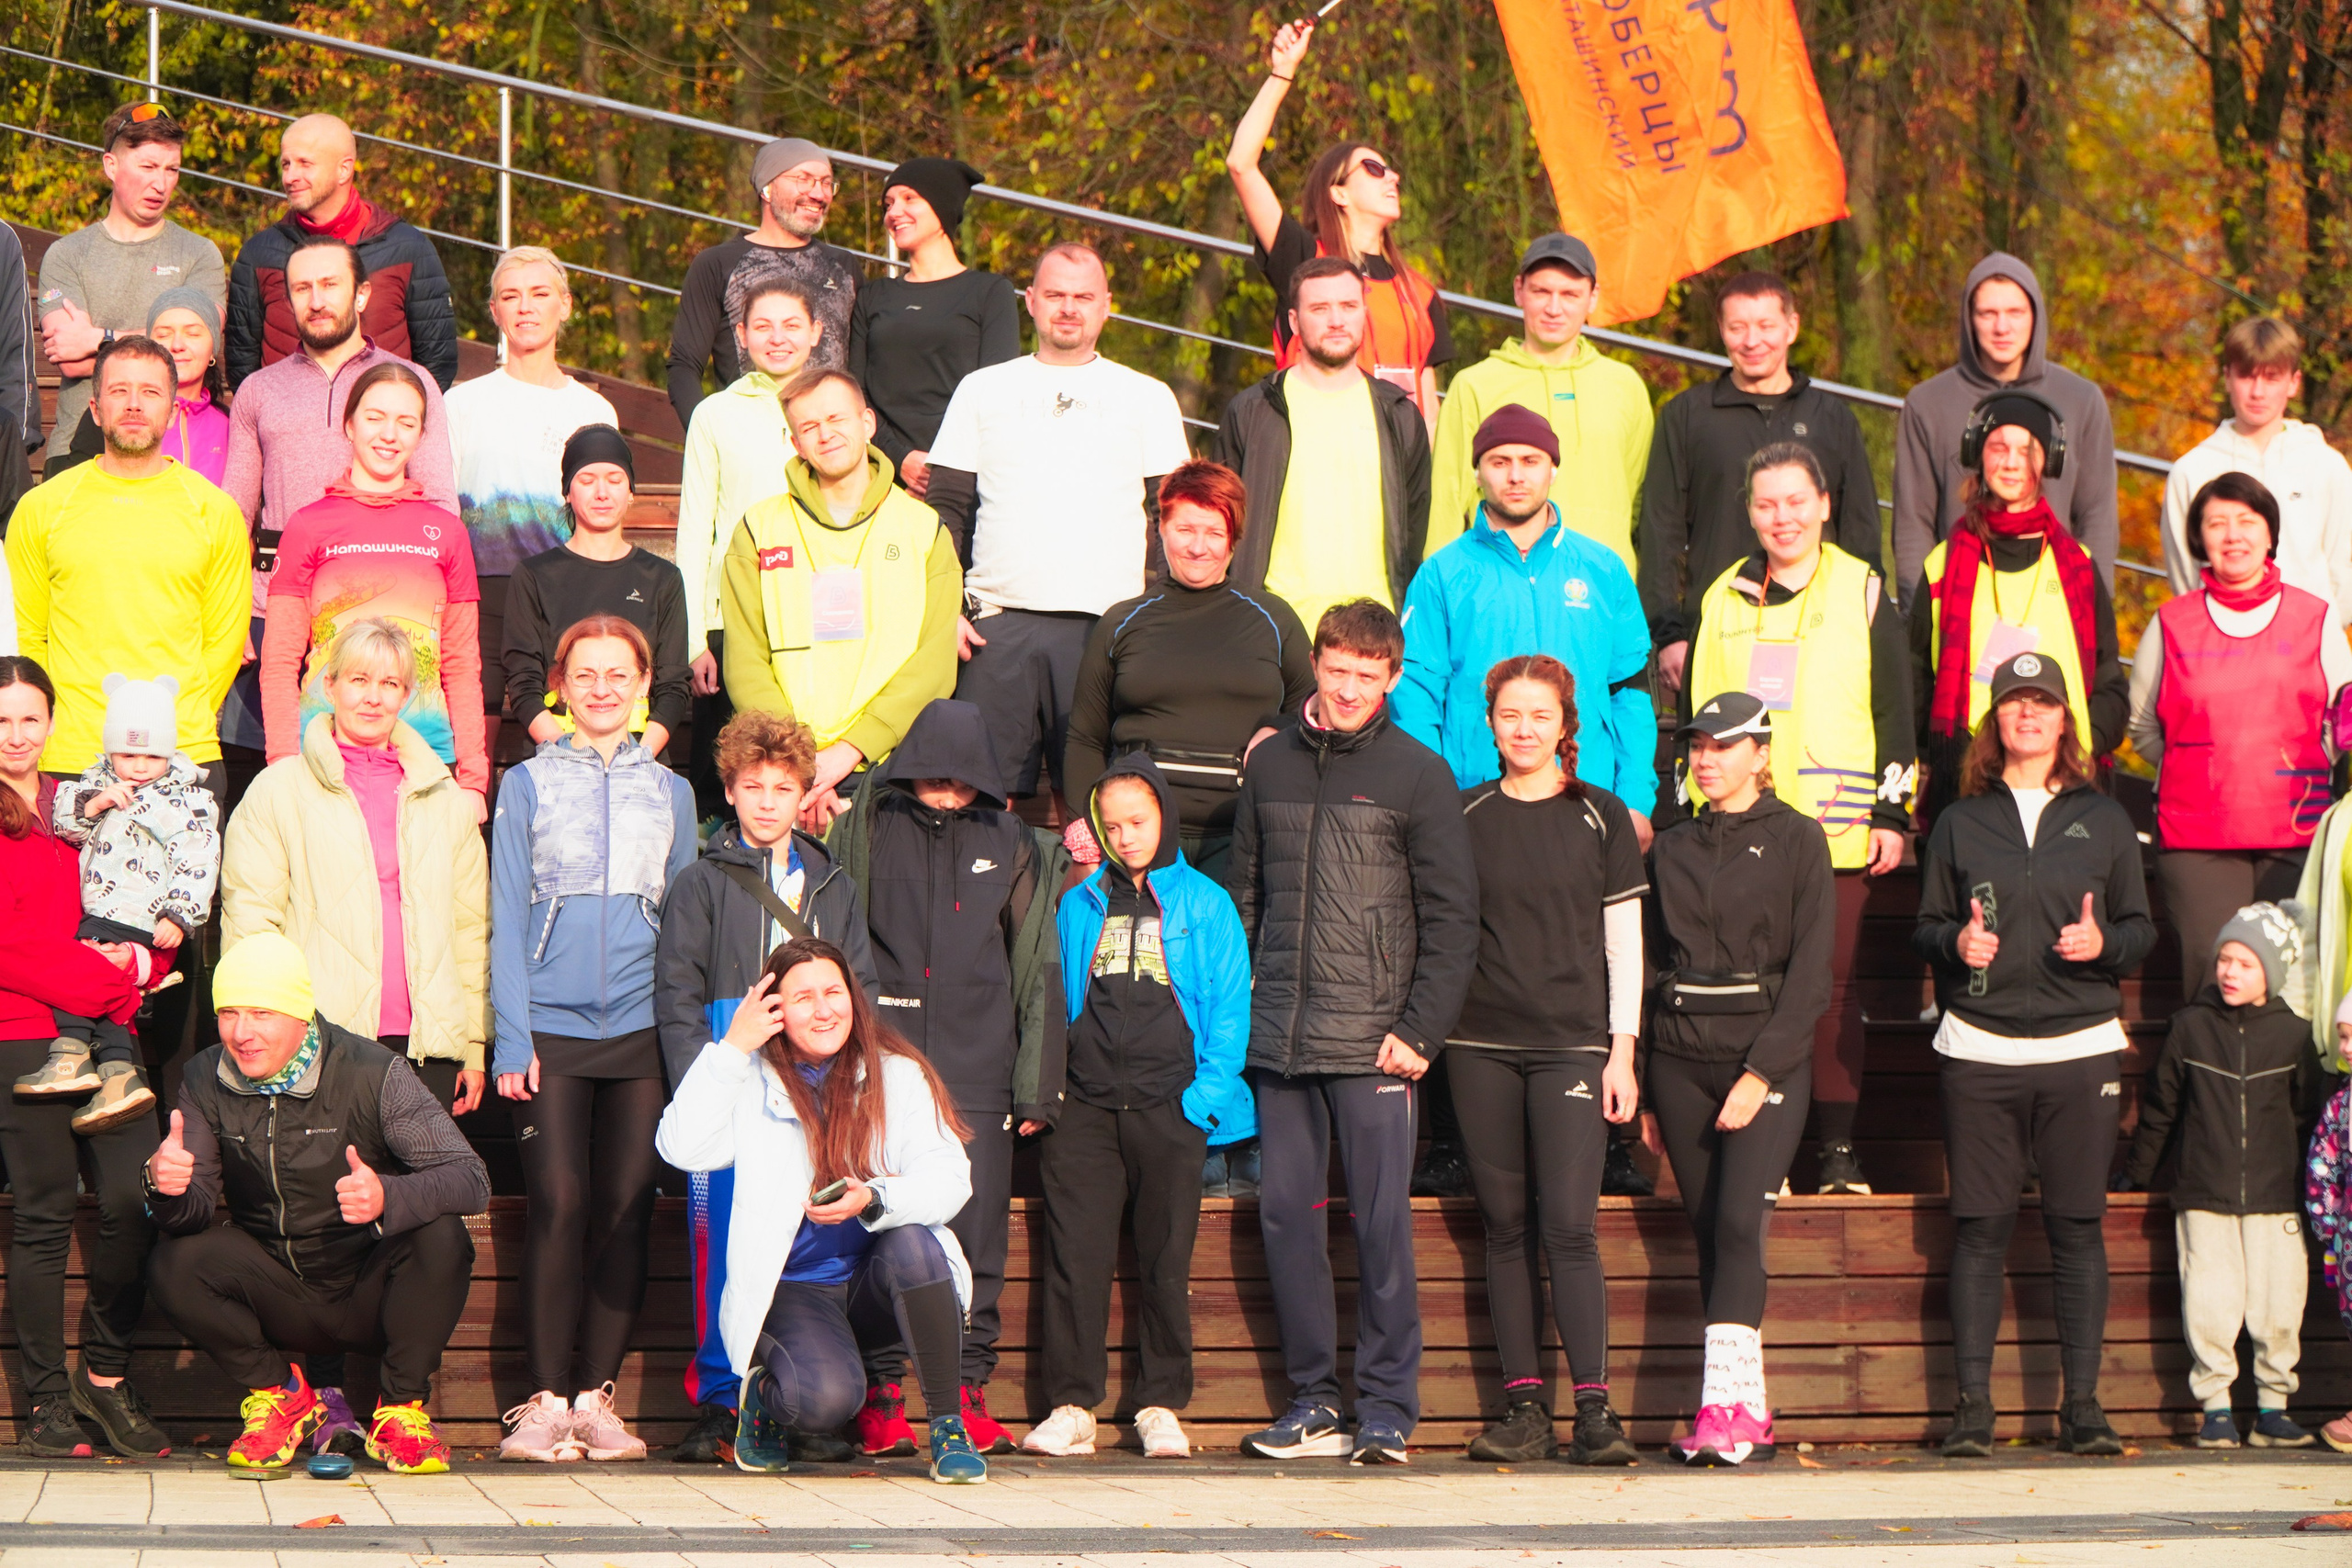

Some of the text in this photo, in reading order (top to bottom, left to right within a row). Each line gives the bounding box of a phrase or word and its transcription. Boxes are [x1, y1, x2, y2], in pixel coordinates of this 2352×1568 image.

[1563, 0, 1636, 170] ТАШИНСКИЙ
[325, 543, 439, 559] Наташинский
[891, 998, 922, 1009] NIKE AIR
[1565, 1089, 1595, 1100] DEMIX
[1709, 1339, 1737, 1348] FILA
[1707, 1363, 1731, 1372] FILA
